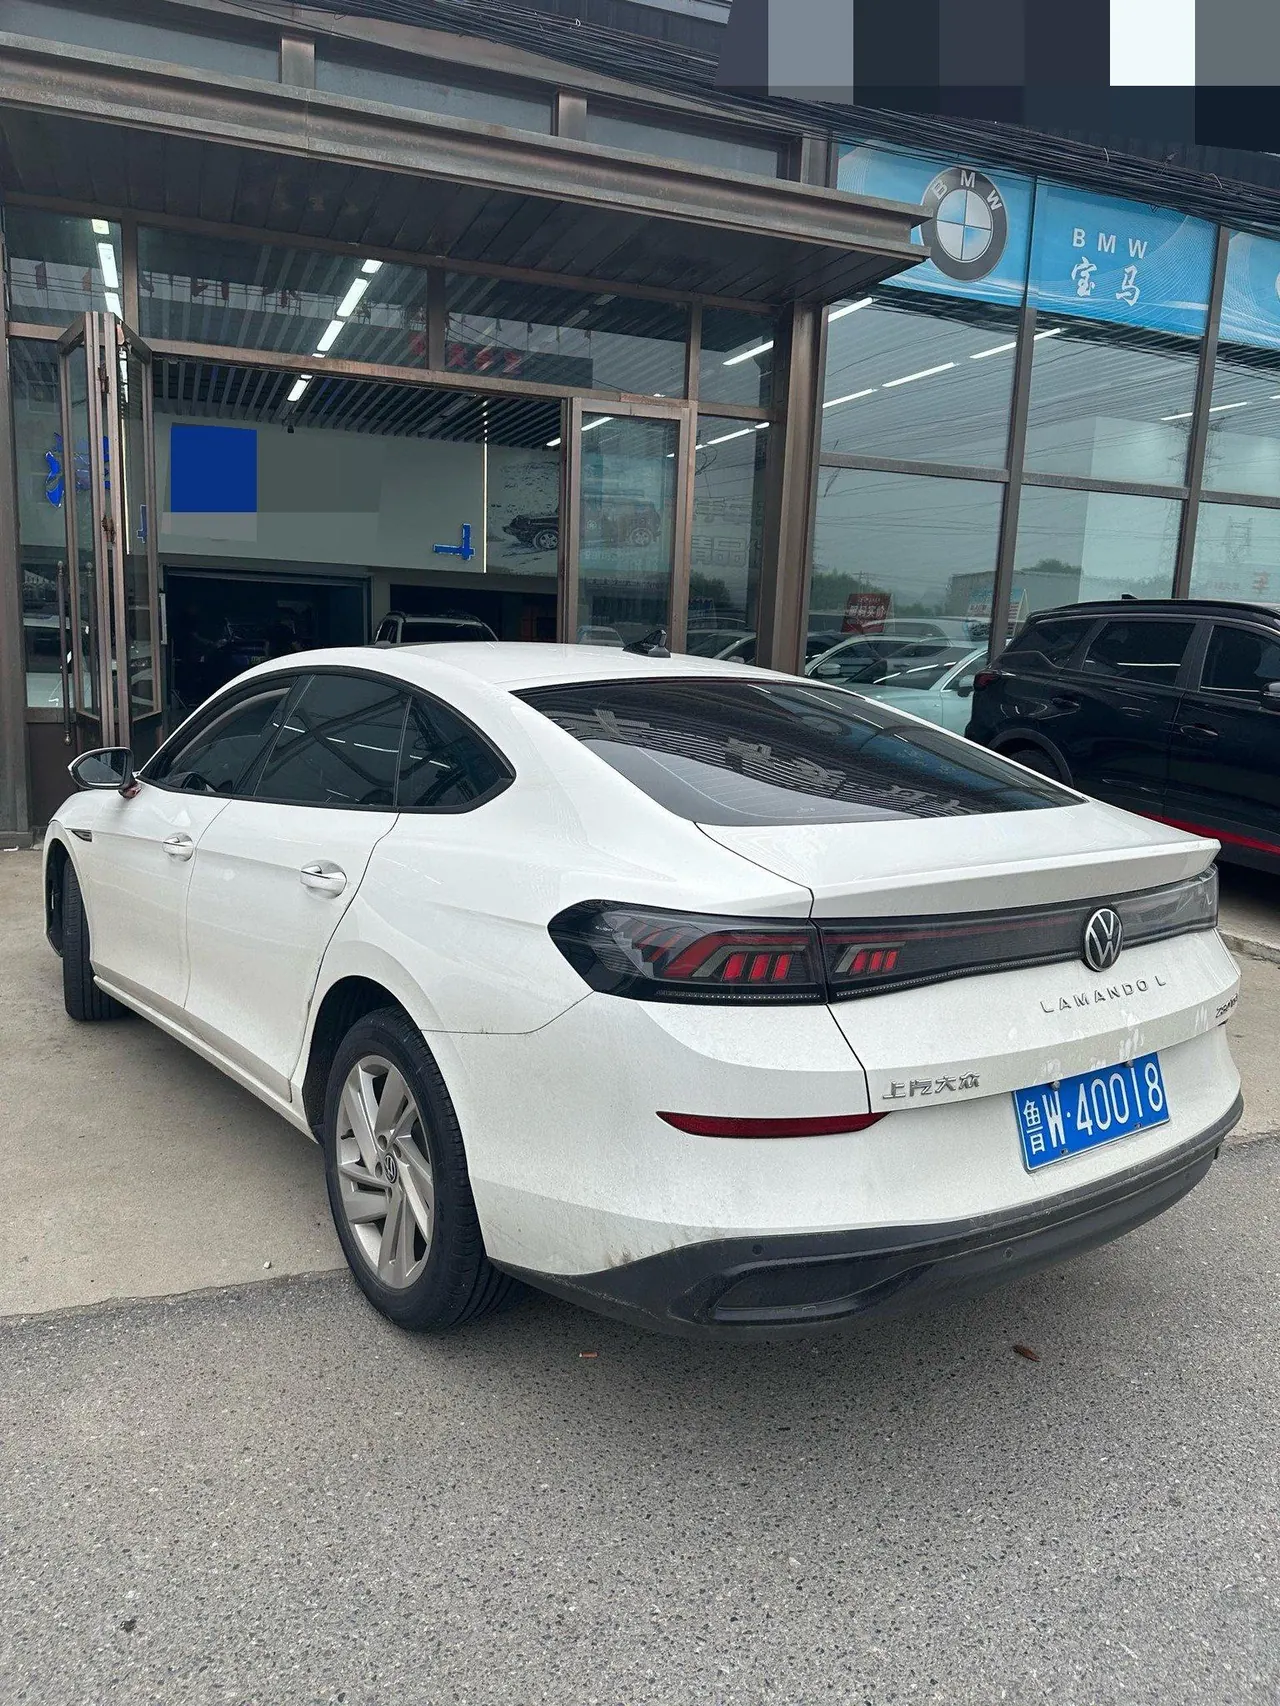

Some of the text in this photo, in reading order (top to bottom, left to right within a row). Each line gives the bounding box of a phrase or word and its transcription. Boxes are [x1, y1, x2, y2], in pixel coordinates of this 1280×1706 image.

[933, 170, 1003, 211] BMW
[1072, 228, 1148, 259] BMW
[1071, 256, 1141, 306] 宝马
[1039, 975, 1167, 1014] LAMANDO L
[882, 1071, 981, 1100] 上汽大众
